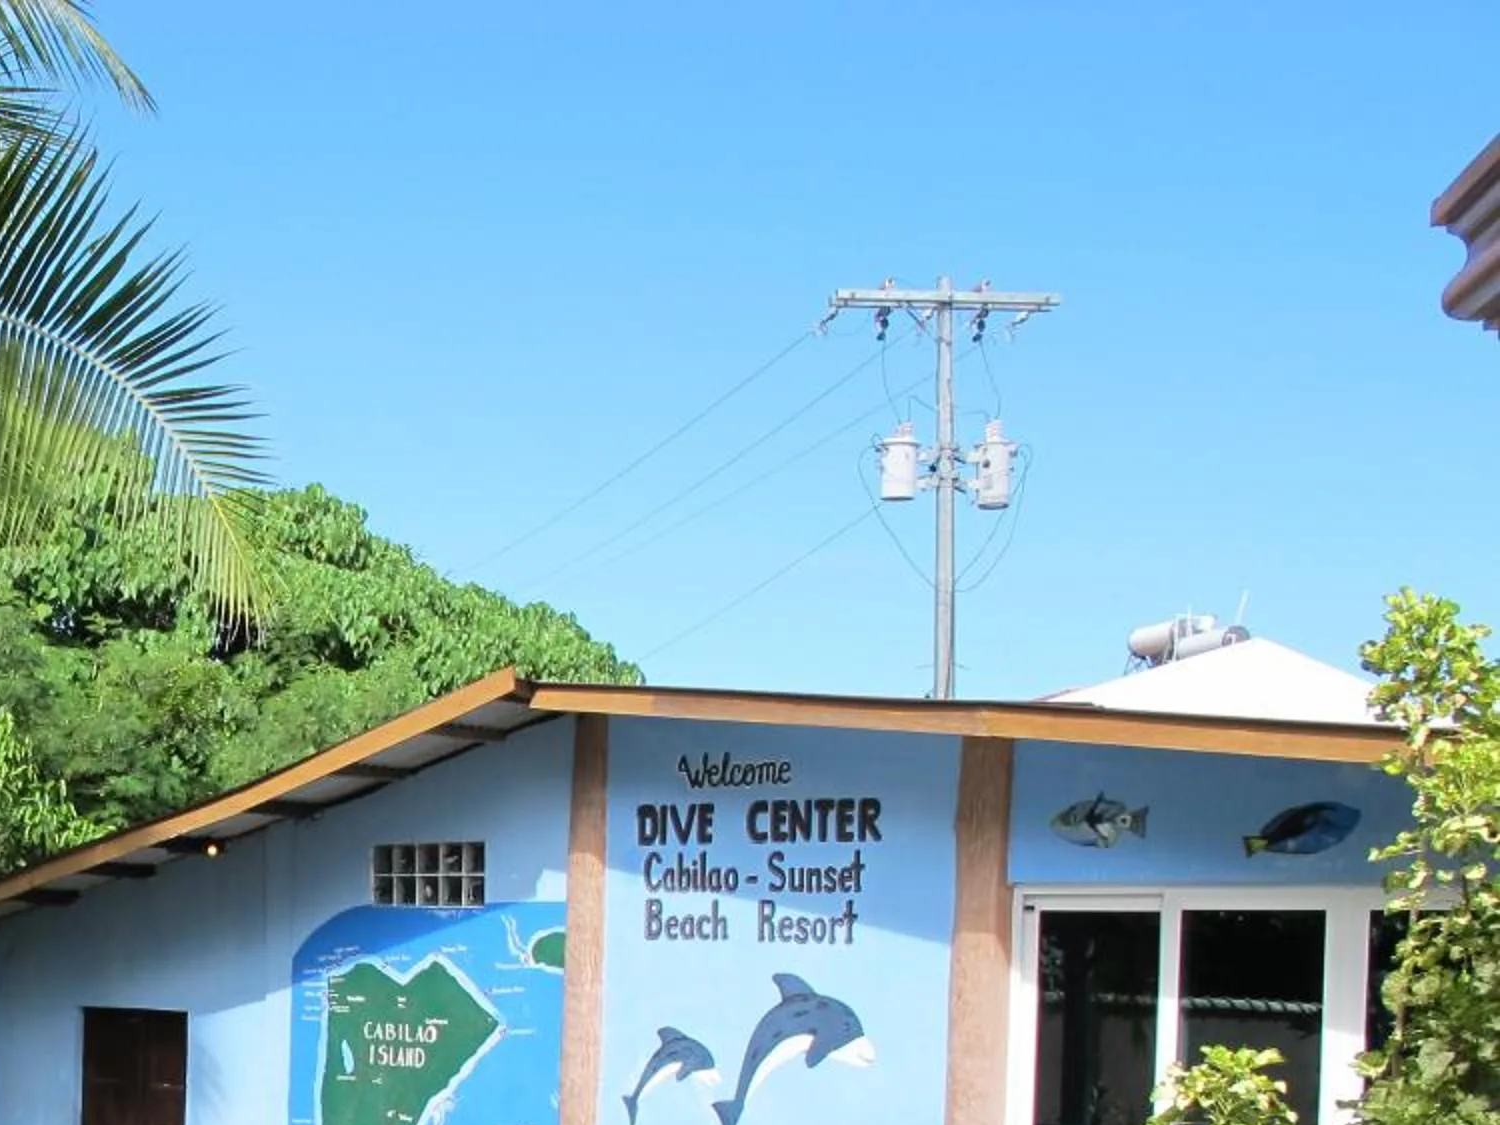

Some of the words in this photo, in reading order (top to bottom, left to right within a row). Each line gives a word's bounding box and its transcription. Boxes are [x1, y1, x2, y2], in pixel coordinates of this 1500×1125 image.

[678, 752, 792, 789] Welcome
[636, 803, 715, 846] DIVE
[746, 797, 883, 844] CENTER
[644, 851, 739, 893] Cabilao
[767, 849, 866, 894] Sunset
[644, 898, 729, 941] Beach
[757, 899, 858, 944] Resort
[363, 1021, 437, 1043] CABILAO
[369, 1045, 426, 1069] ISLAND
